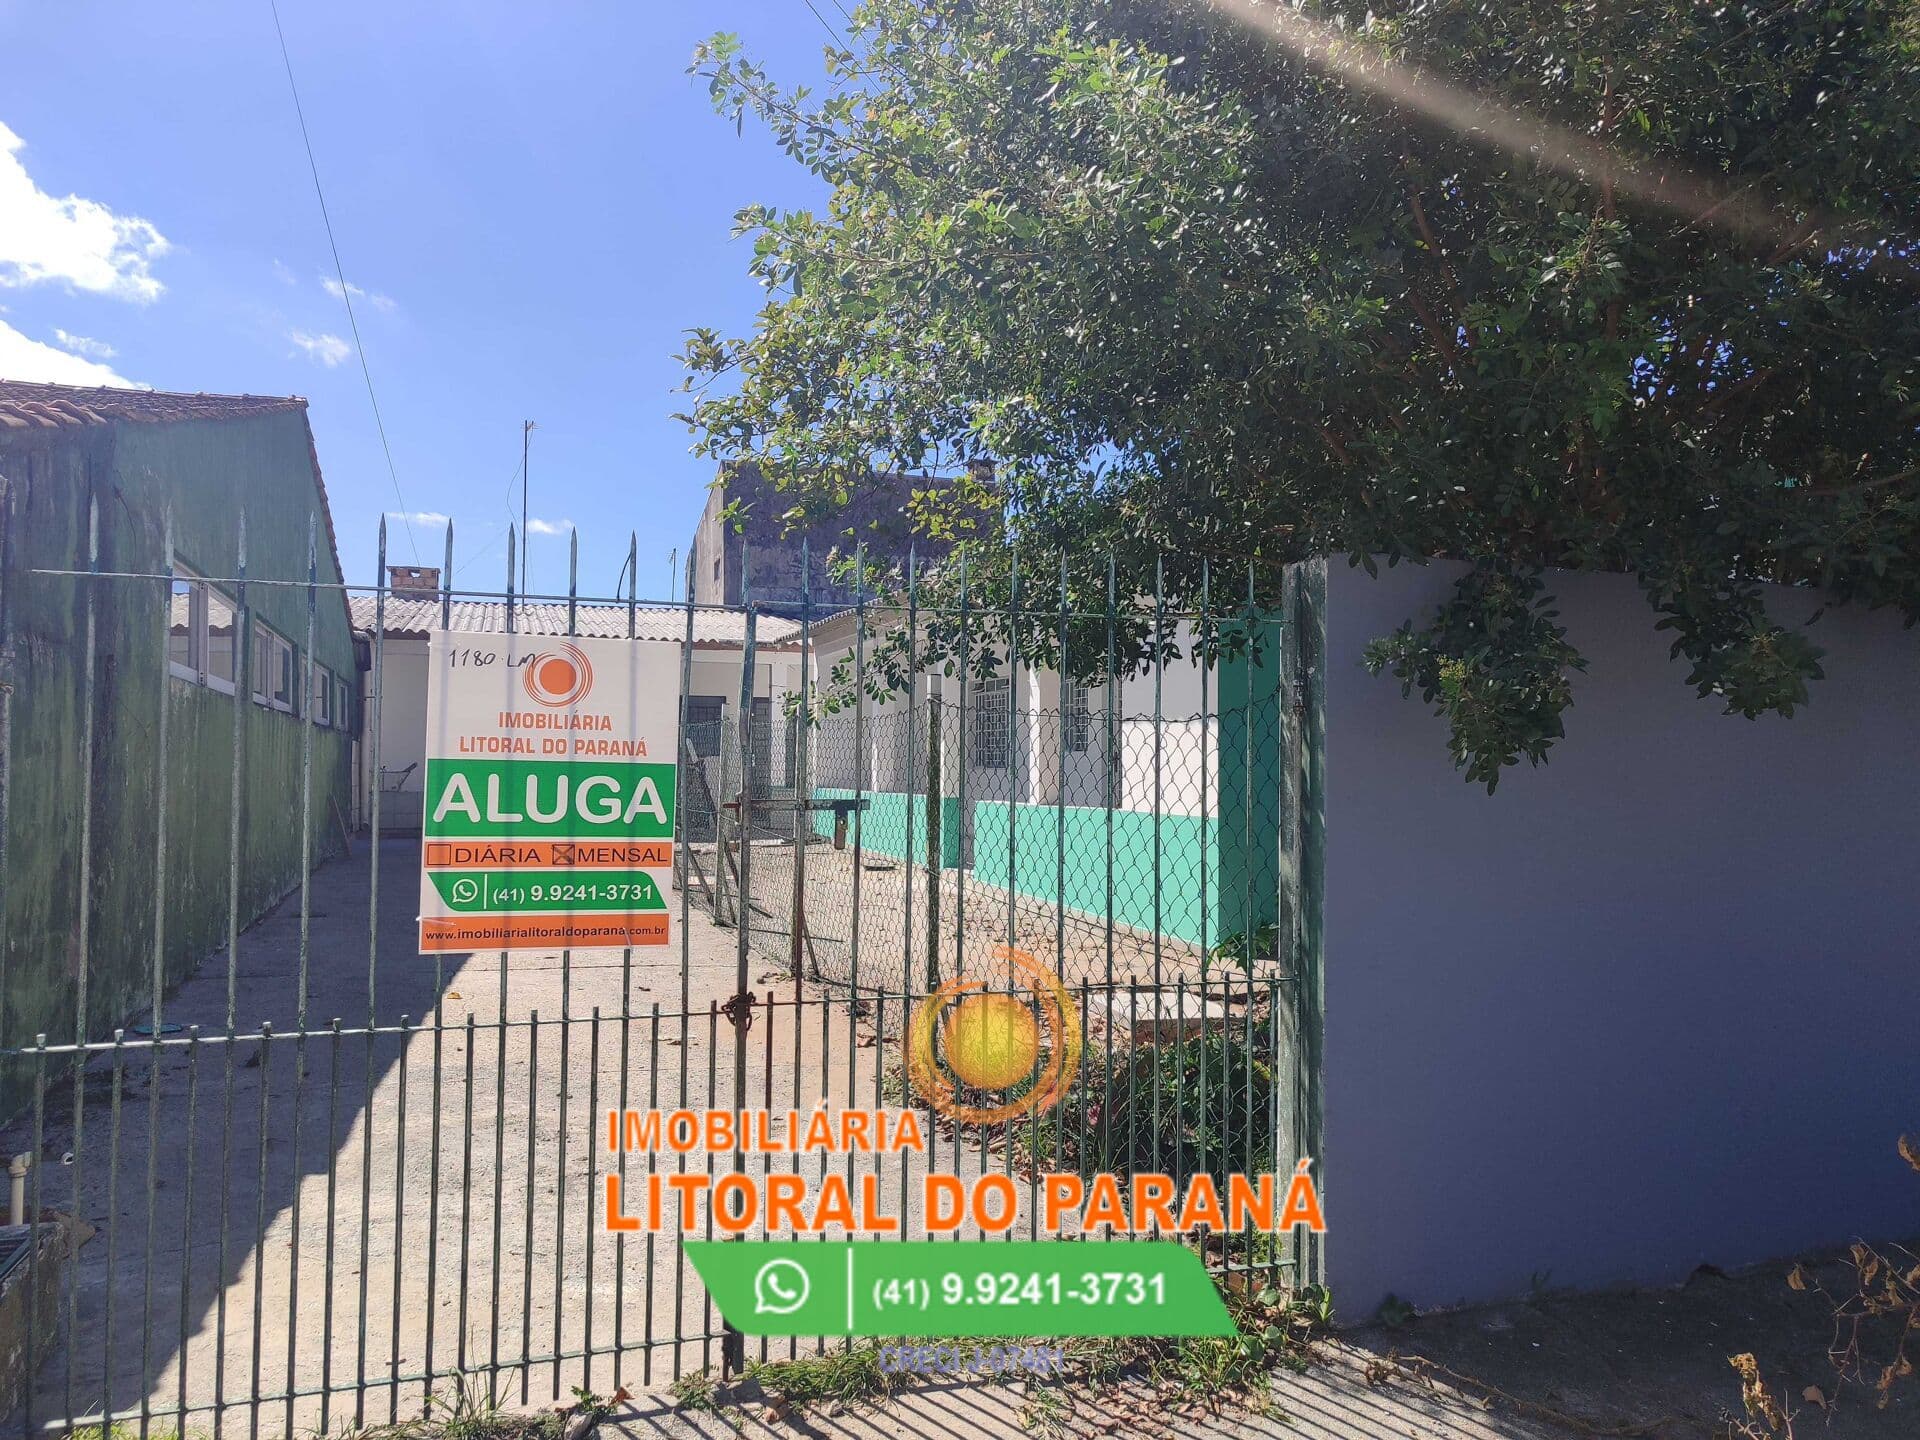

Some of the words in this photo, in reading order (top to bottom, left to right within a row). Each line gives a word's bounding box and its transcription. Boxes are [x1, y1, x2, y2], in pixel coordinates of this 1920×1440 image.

[449, 649, 496, 668] 1180
[498, 710, 612, 731] IMOBILIÁRIA
[460, 736, 535, 754] LITORAL
[542, 739, 567, 755] DO
[574, 737, 647, 757] PARANÁ
[432, 773, 668, 824] ALUGA
[455, 844, 541, 863] DIÁRIA
[577, 847, 667, 862] MENSAL
[493, 888, 525, 905] (41)
[531, 884, 652, 901] 9.9241-3731
